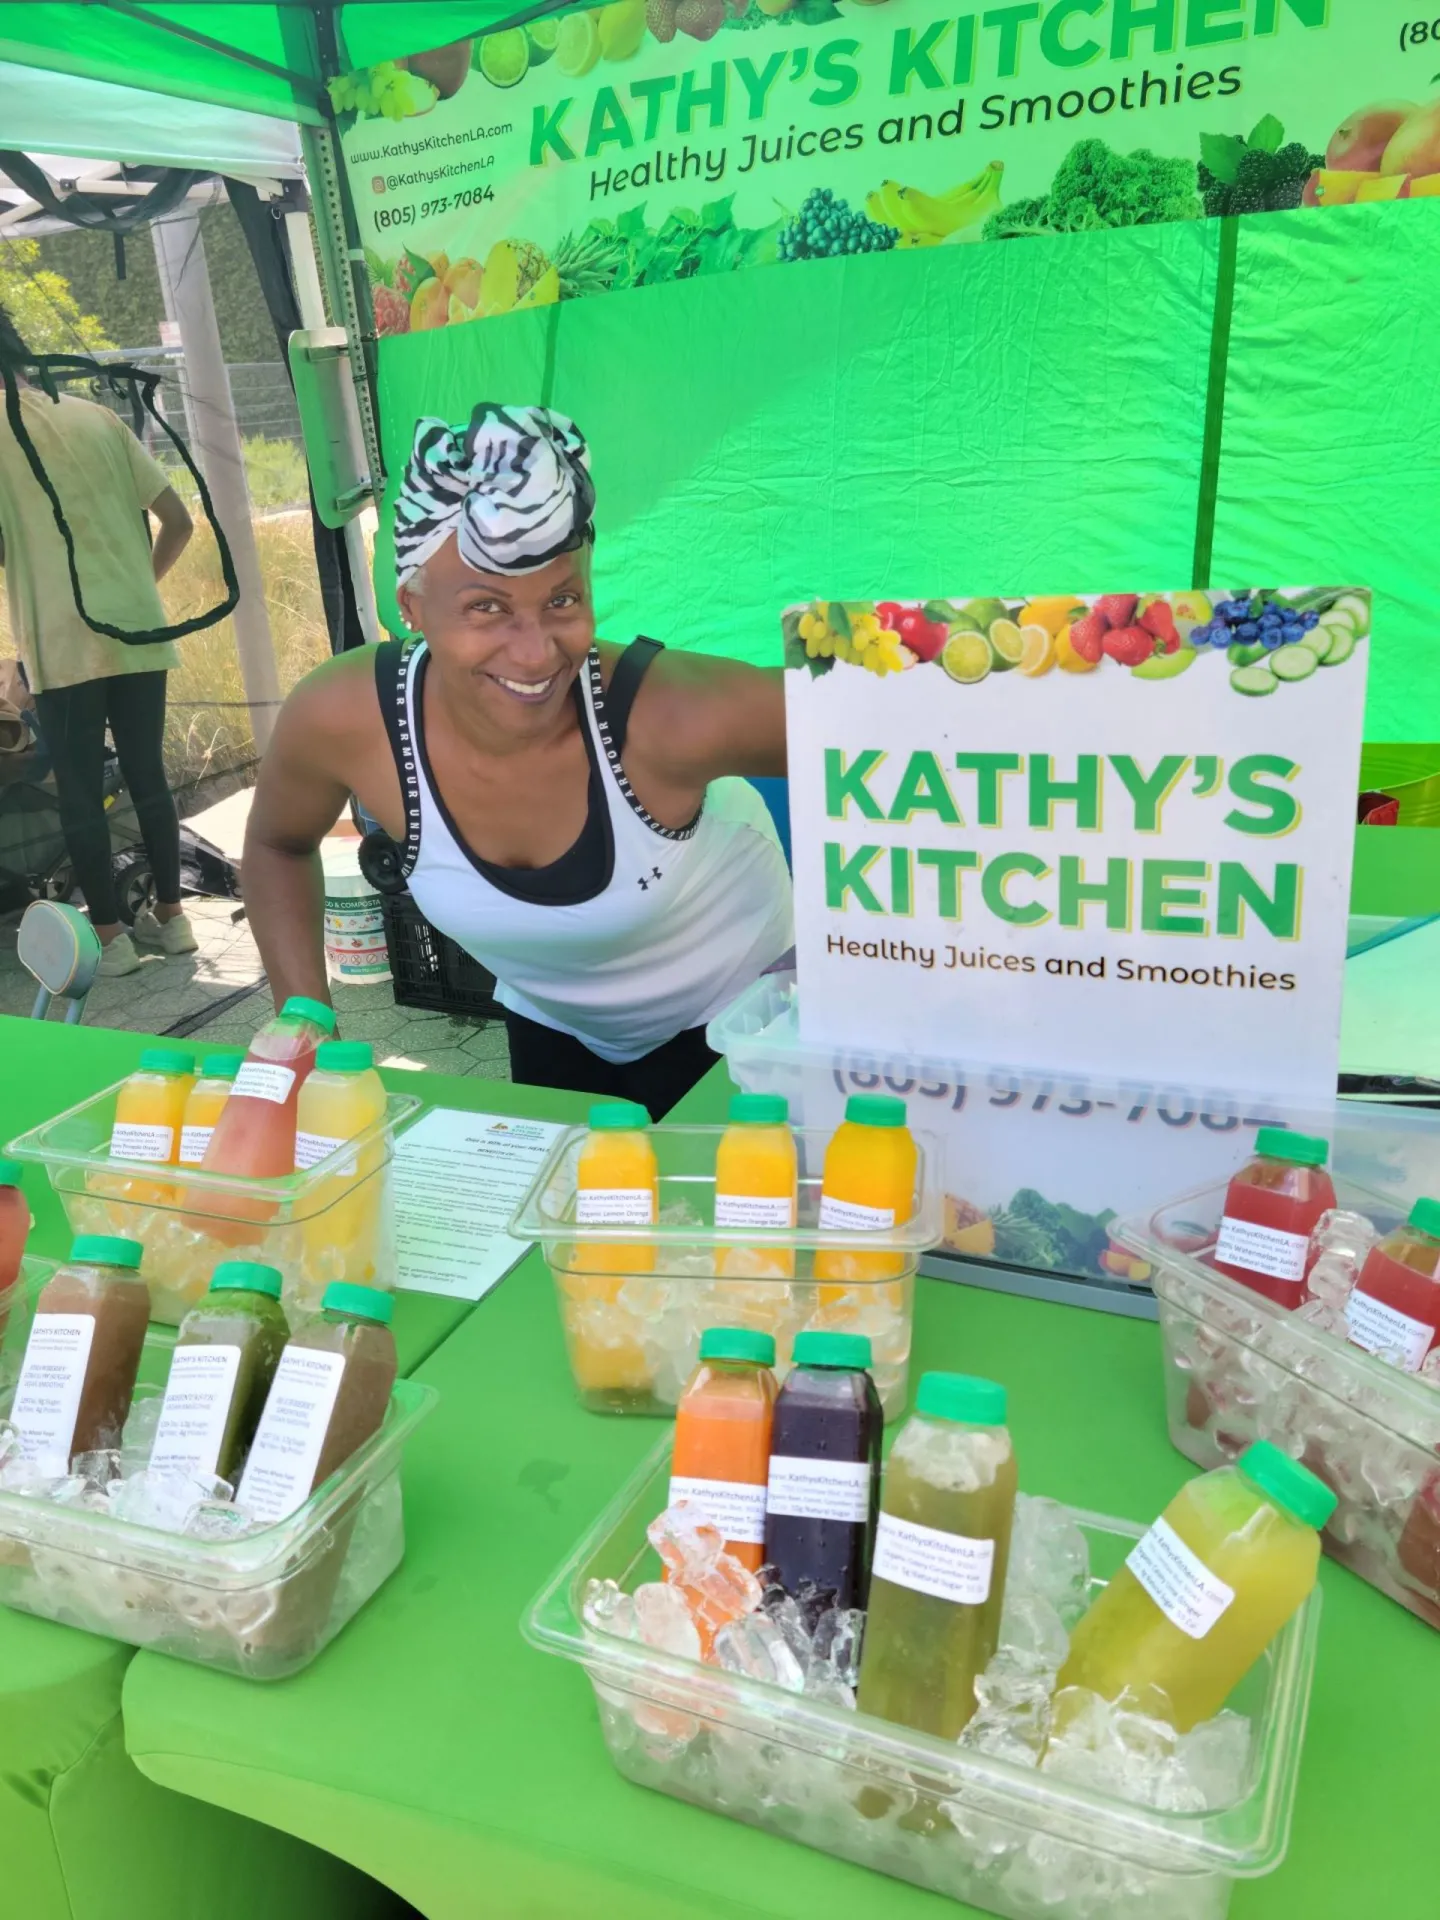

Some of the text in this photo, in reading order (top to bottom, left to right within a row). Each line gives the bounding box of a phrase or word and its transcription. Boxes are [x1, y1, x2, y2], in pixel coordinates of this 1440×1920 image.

[529, 38, 863, 168] KATHY'S
[590, 62, 1244, 201] Healthy Juices and Smoothies
[350, 122, 514, 164] www.KathysKitchenLA.com
[386, 155, 496, 191] @KathysKitchenLA
[373, 184, 496, 233] (805) 973-7084
[396, 643, 416, 706] UNDER
[588, 646, 605, 711] UNDER
[397, 719, 419, 800] ARMOUR
[598, 720, 637, 798] ARMOUR
[823, 748, 1304, 839] KATHY'S
[405, 808, 420, 862] UNDER
[823, 841, 1304, 942] KITCHEN
[826, 934, 1297, 992] Healthy Juices and Smoothies
[832, 1047, 967, 1111] (805)
[1234, 1244, 1278, 1262] Watermelon
[1278, 1257, 1299, 1269] Juice
[1351, 1317, 1394, 1346] Watermelon
[805, 1505, 830, 1515] Natural
[831, 1508, 851, 1518] Sugar
